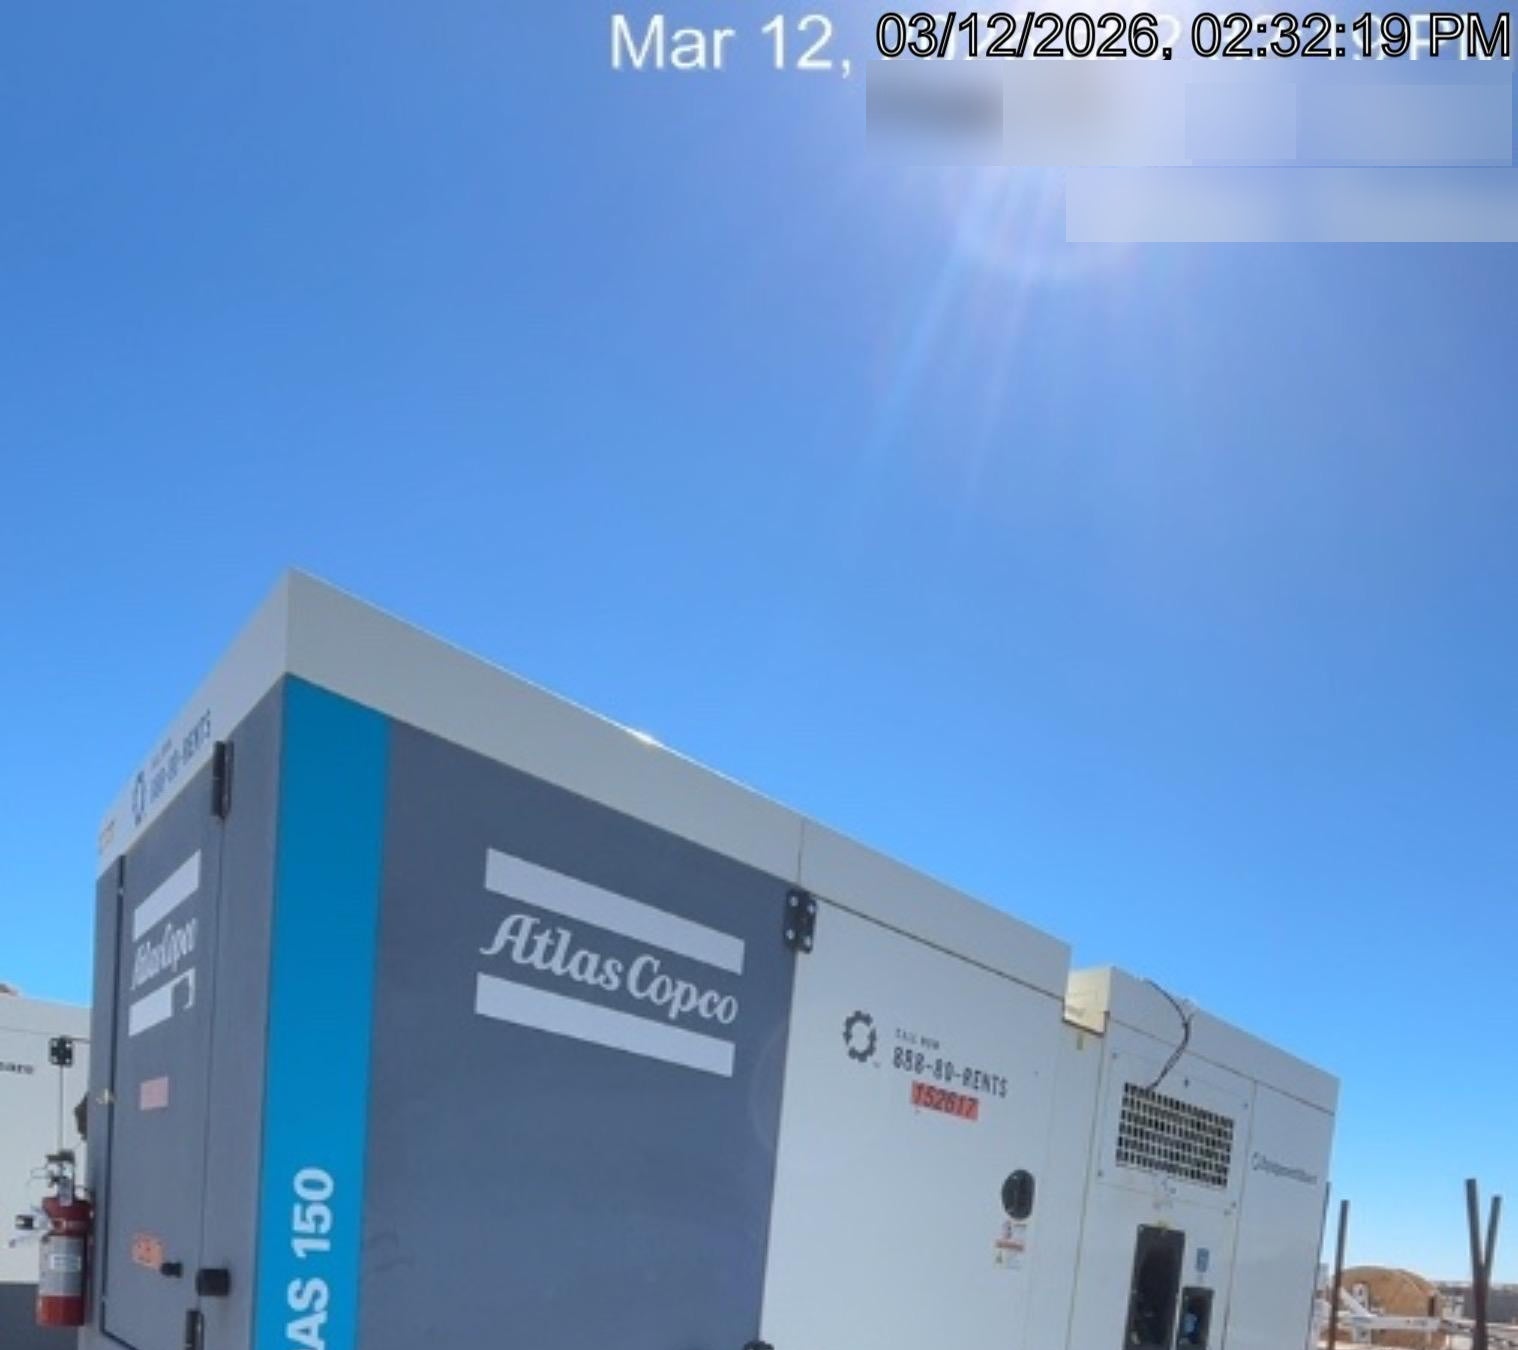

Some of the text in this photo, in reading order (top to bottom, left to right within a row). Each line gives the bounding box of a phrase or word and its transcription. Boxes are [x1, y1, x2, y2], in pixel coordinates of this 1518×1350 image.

[479, 913, 738, 1025] Atlas Copco
[290, 1166, 334, 1260] 150
